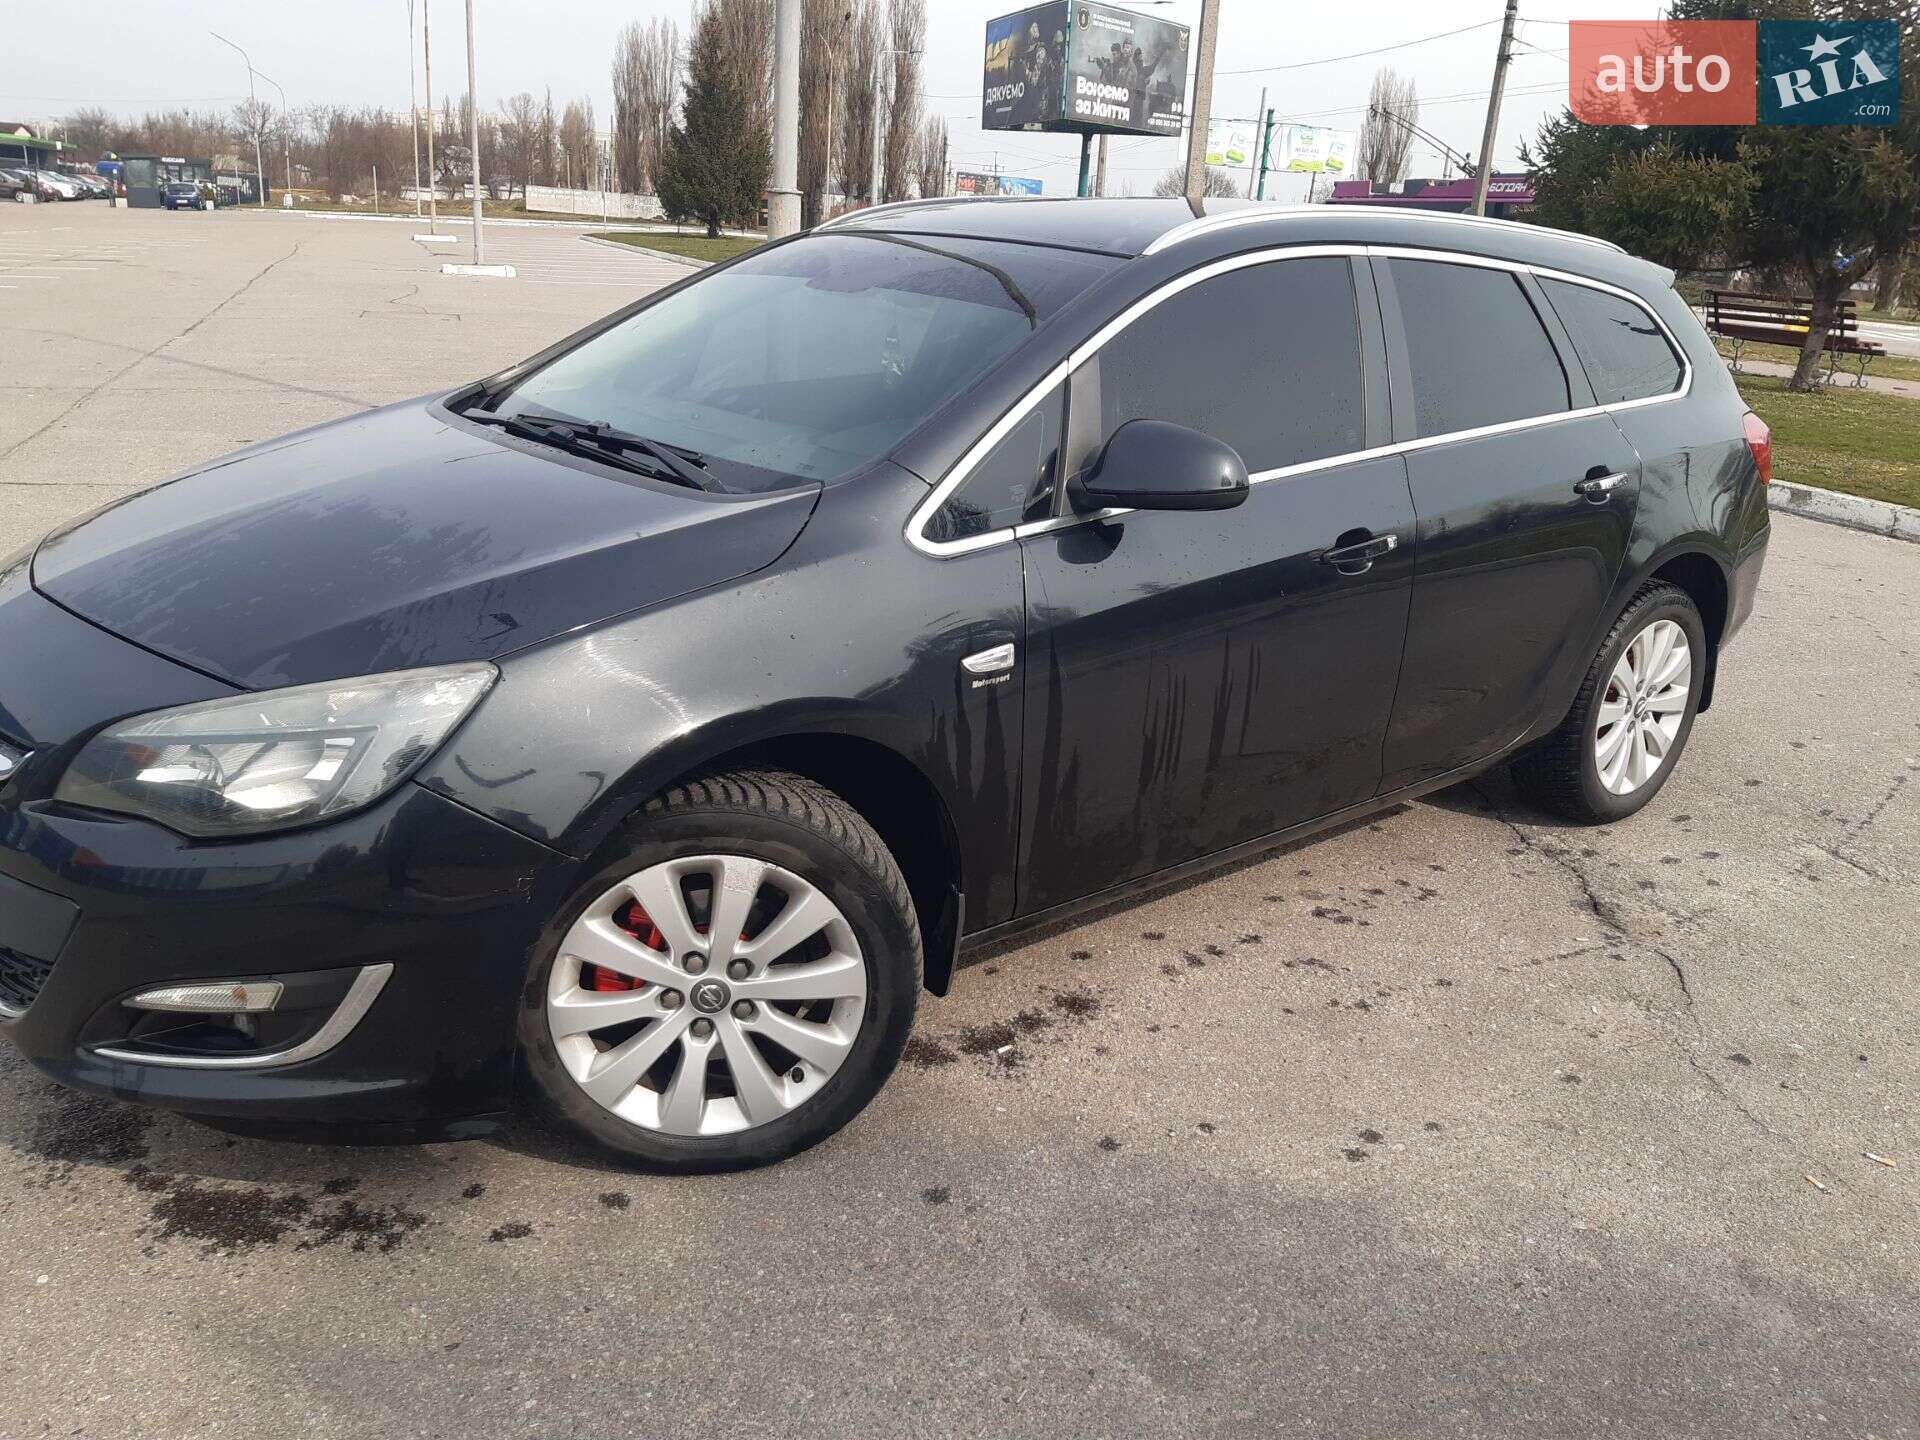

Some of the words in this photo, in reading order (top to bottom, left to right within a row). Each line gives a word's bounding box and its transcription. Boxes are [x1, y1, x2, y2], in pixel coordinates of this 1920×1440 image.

[986, 82, 1025, 106] ДЯКУЄМО
[1076, 76, 1129, 102] Воюємо
[1092, 97, 1131, 121] життя
[972, 674, 1010, 687] Motorsport
